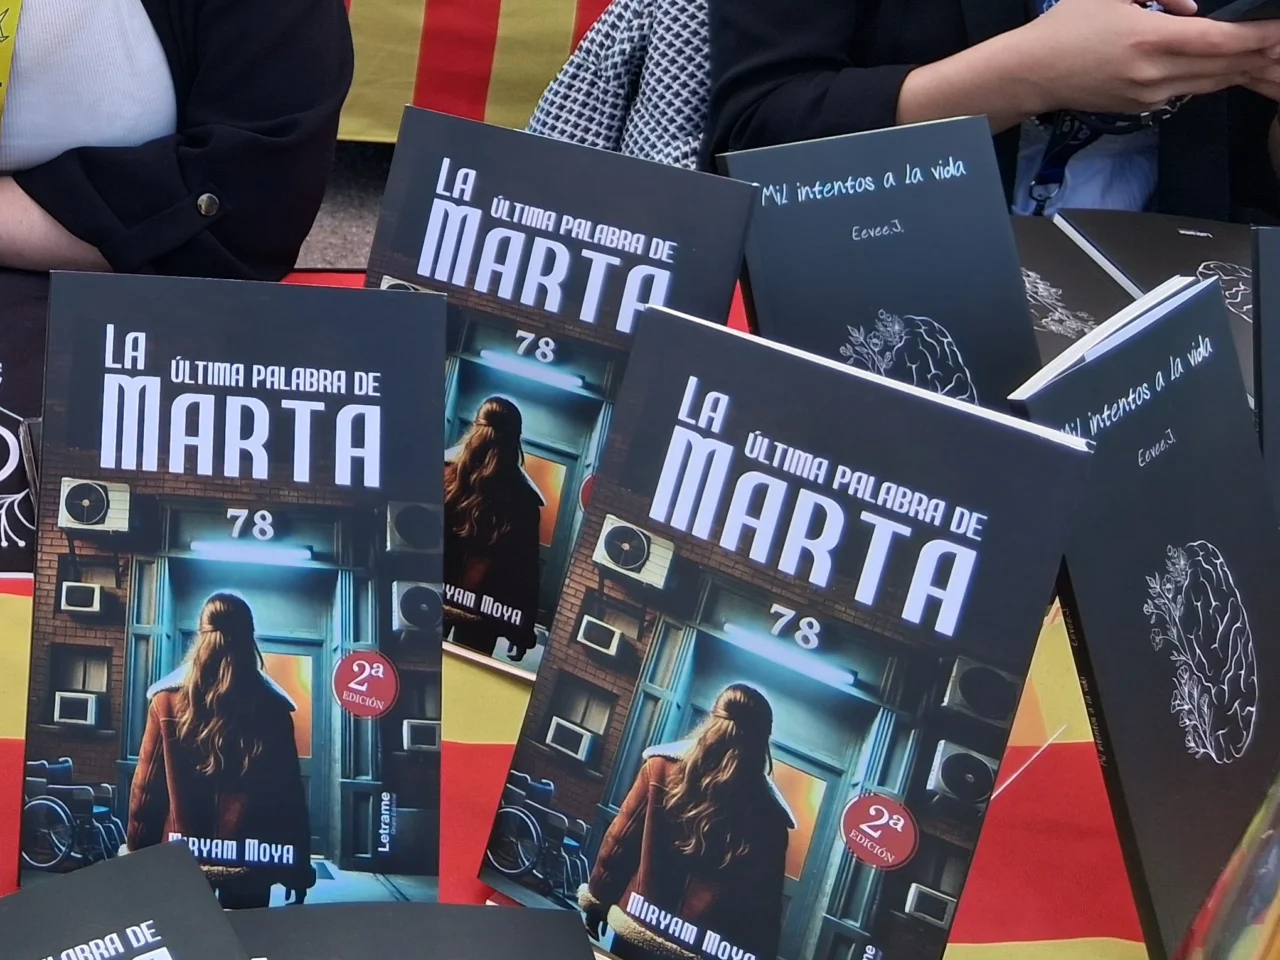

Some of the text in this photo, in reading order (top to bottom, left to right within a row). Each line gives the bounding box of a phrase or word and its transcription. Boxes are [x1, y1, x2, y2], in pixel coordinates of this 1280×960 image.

[435, 157, 477, 202] LA
[796, 175, 875, 203] intentos
[883, 171, 896, 188] a
[931, 156, 967, 180] vida
[490, 194, 678, 264] ÚLTIMA PALABRA DE
[416, 197, 672, 334] MARTA
[104, 323, 147, 370] LA
[515, 329, 556, 364] 78
[170, 355, 381, 397] ÚLTIMA PALABRA DE
[1088, 382, 1151, 436] intentos
[1155, 371, 1165, 391] a
[1187, 335, 1213, 367] vida
[677, 375, 730, 434] LA
[100, 373, 382, 488] MARTA
[743, 430, 988, 541] ÚLTIMA PALABRA DE
[226, 508, 275, 540] 78
[648, 424, 978, 637] MARTA
[480, 594, 522, 626] MOYA
[768, 603, 821, 650] 78
[342, 690, 386, 711] EDICIÓN
[377, 791, 391, 852] Letrame
[244, 838, 294, 865] MOYA
[848, 828, 895, 865] EDICIÓN
[126, 920, 162, 948] DE
